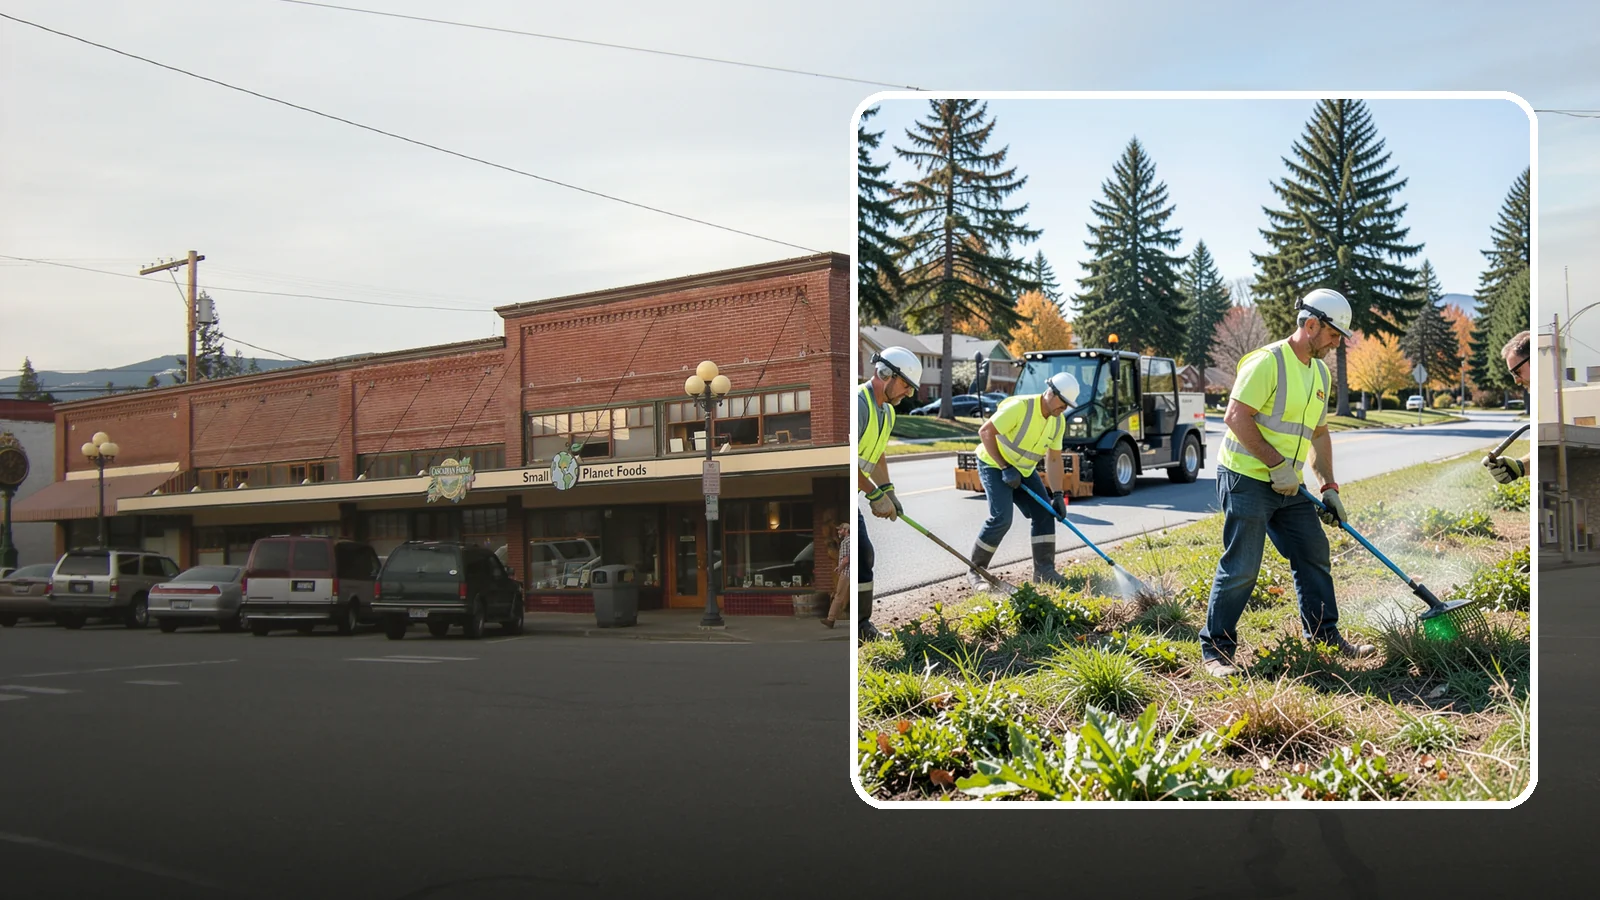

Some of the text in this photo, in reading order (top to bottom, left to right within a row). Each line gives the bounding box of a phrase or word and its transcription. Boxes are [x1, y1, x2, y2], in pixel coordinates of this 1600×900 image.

[523, 465, 647, 483] Small Planet Foods
